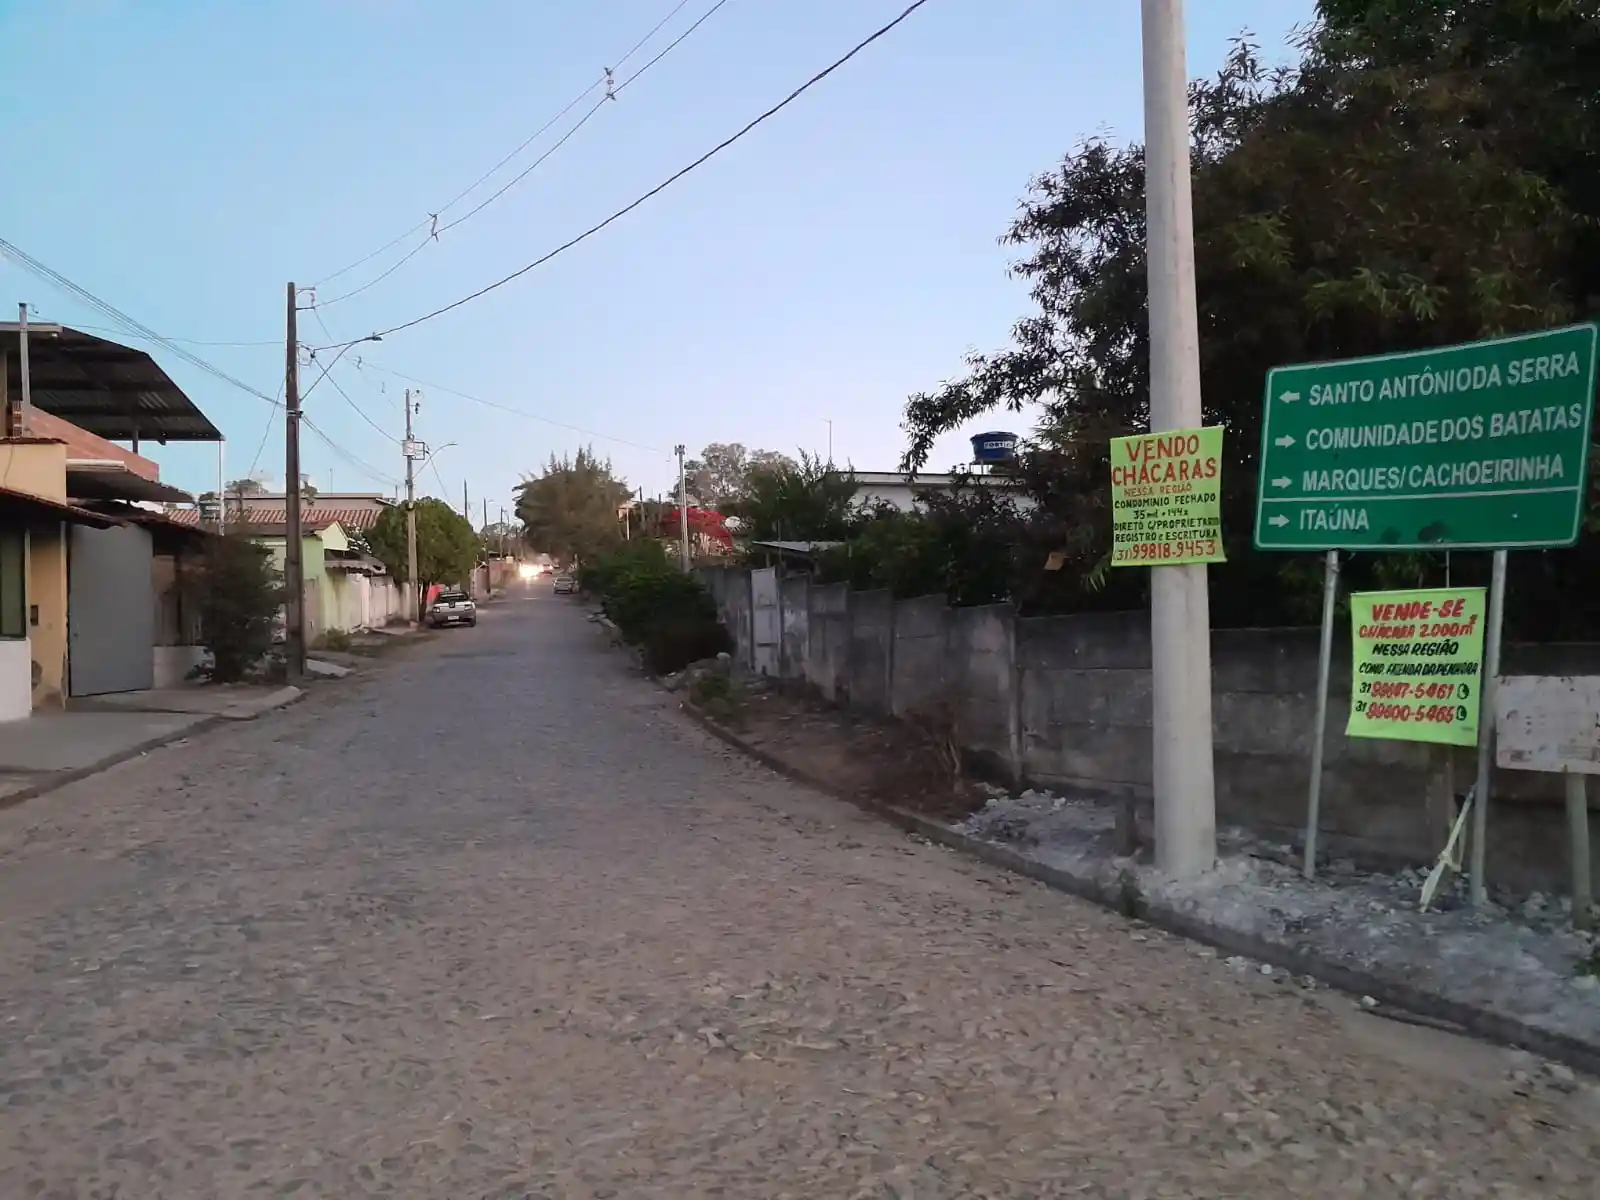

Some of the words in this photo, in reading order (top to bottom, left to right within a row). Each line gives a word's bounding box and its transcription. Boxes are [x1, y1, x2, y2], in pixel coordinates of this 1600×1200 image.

[1308, 379, 1374, 406] SANTO
[1506, 351, 1580, 386] SERRA
[1489, 403, 1582, 438] BATATAS
[1124, 434, 1200, 462] VENDO
[1174, 492, 1216, 505] FECHADO
[1114, 520, 1144, 531] DIRETO
[1300, 503, 1370, 531] ITAÚNA
[1114, 531, 1157, 543] REGISTRO
[1165, 528, 1218, 541] ESCRITURA
[1372, 598, 1465, 622] VENDE-SE
[1372, 643, 1410, 656] NESSA
[1411, 638, 1459, 656] REGIÃO
